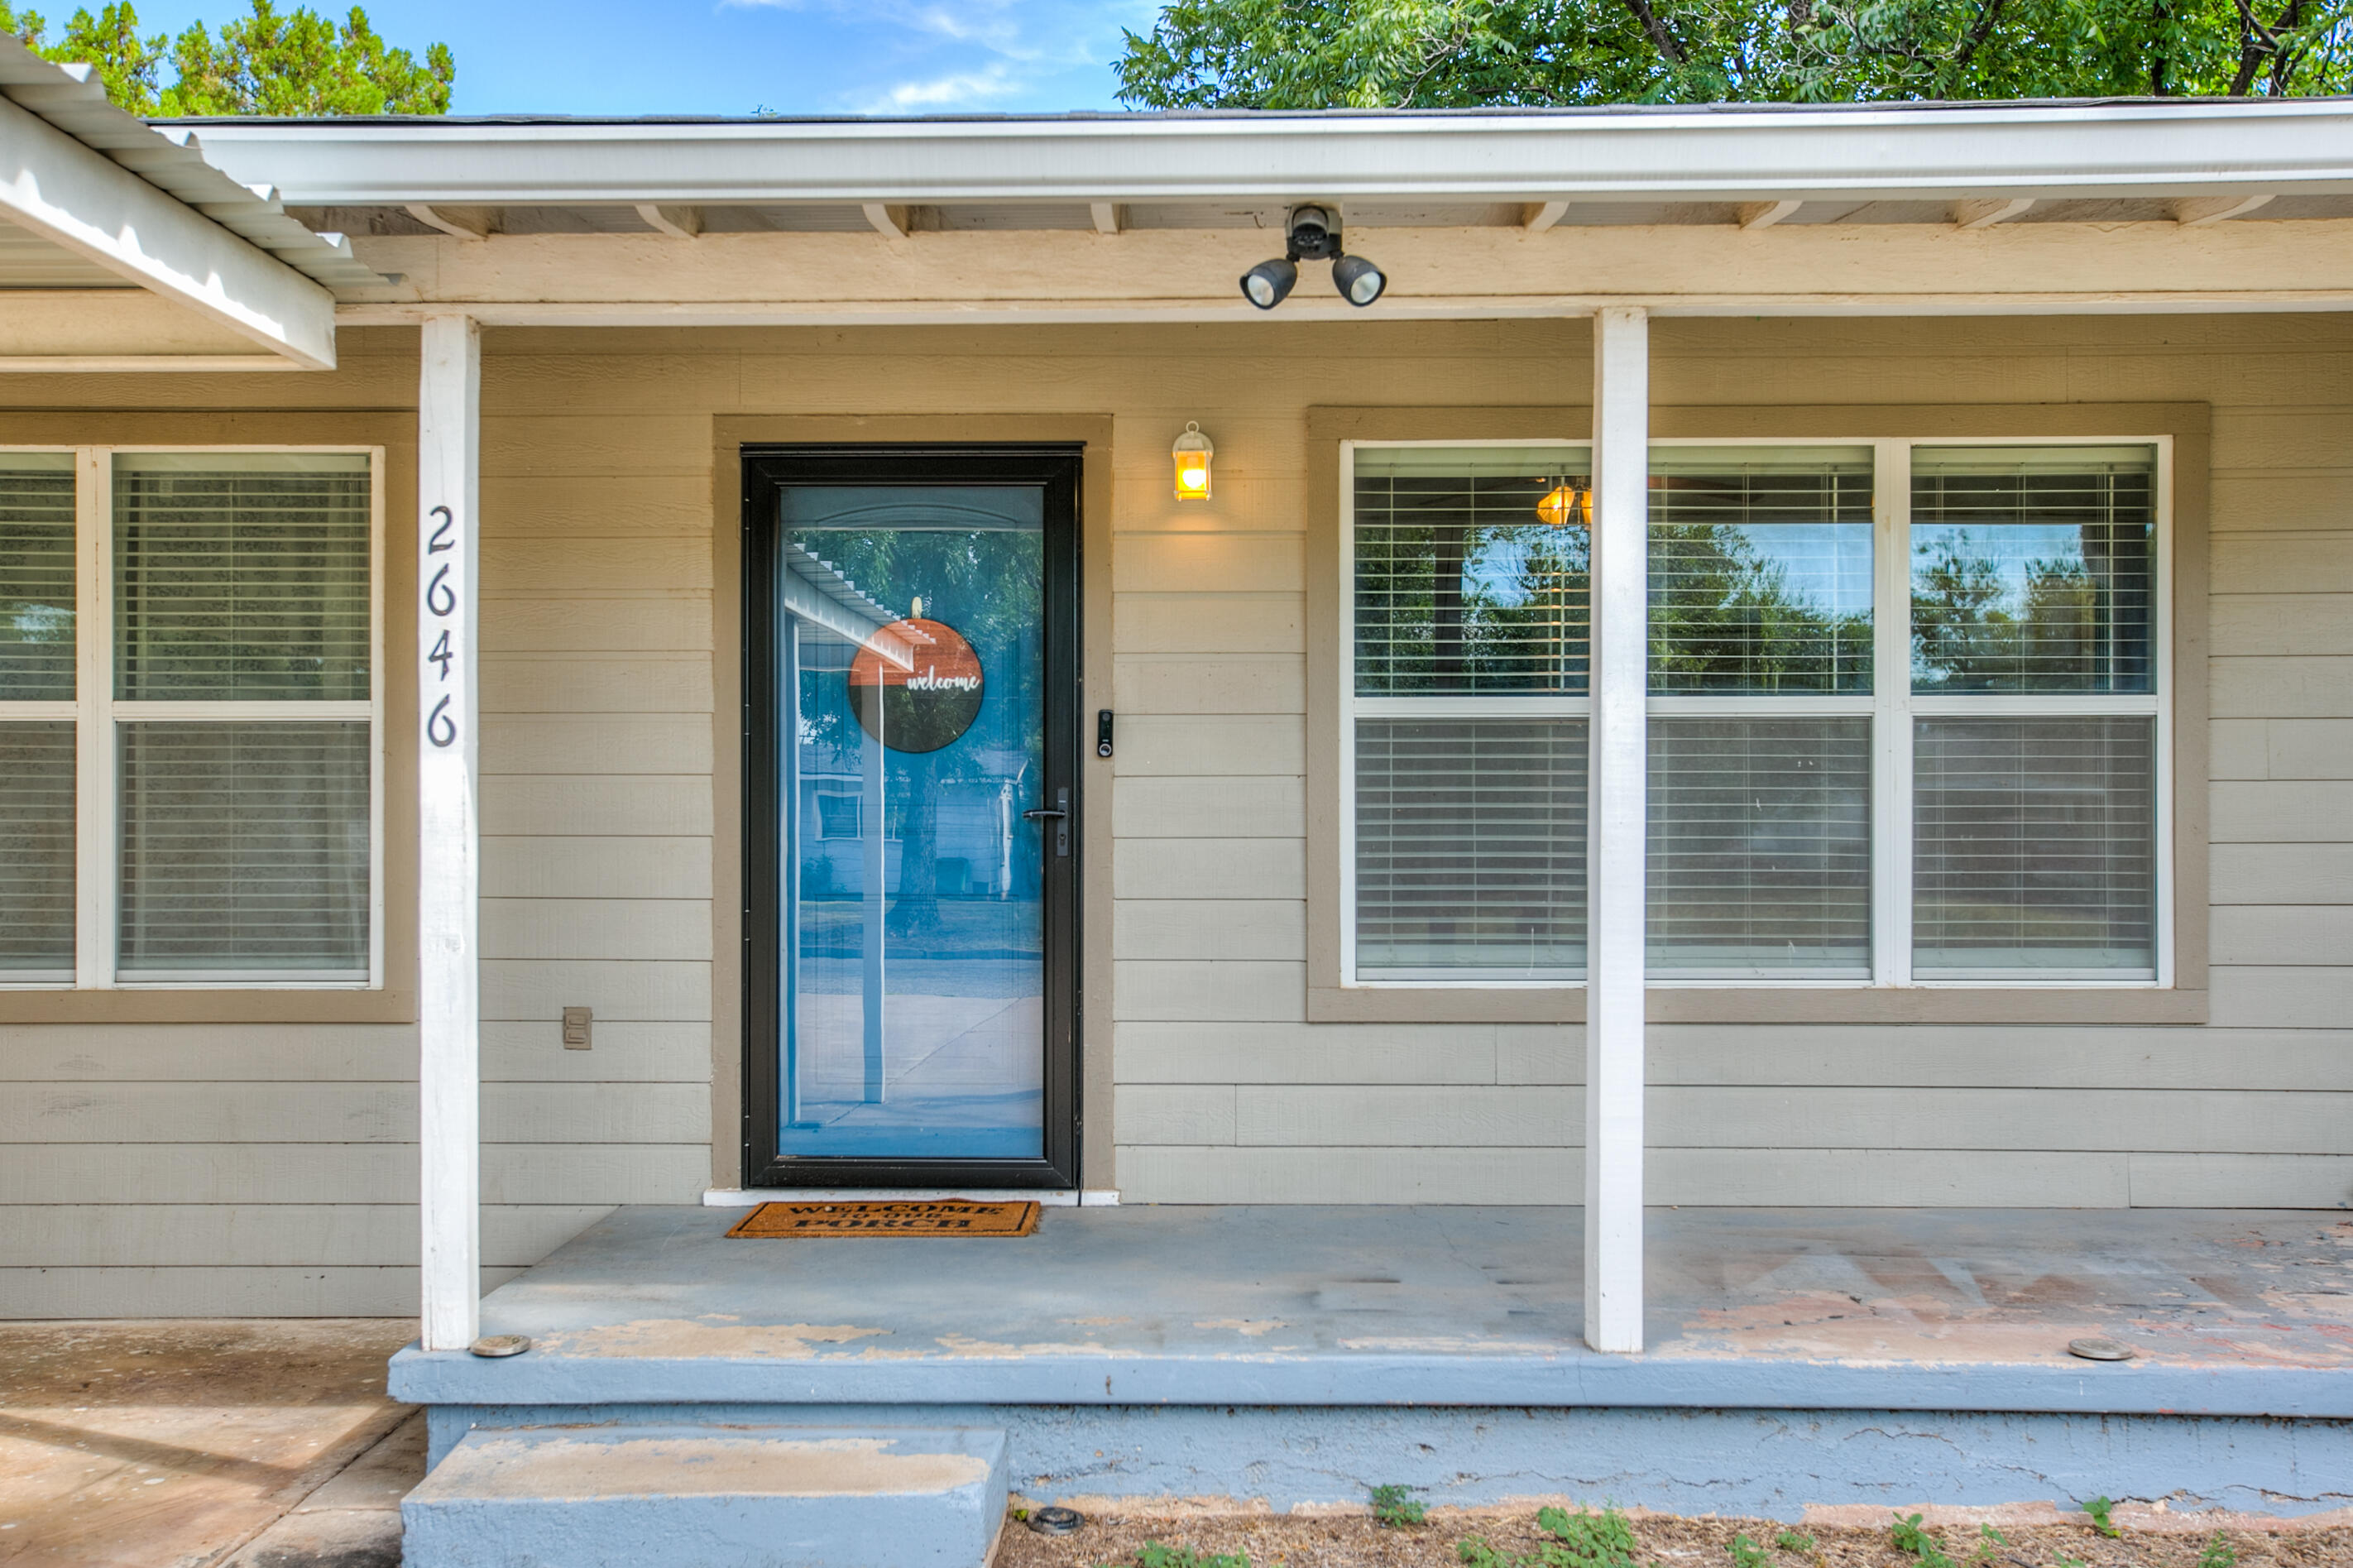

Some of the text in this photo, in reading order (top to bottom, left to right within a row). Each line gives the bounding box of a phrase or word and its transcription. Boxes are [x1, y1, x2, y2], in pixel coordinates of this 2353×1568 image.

[427, 506, 457, 748] 2646
[907, 664, 980, 692] welcome
[789, 1204, 1004, 1215] WELCOME
[794, 1219, 971, 1228] PORCH
